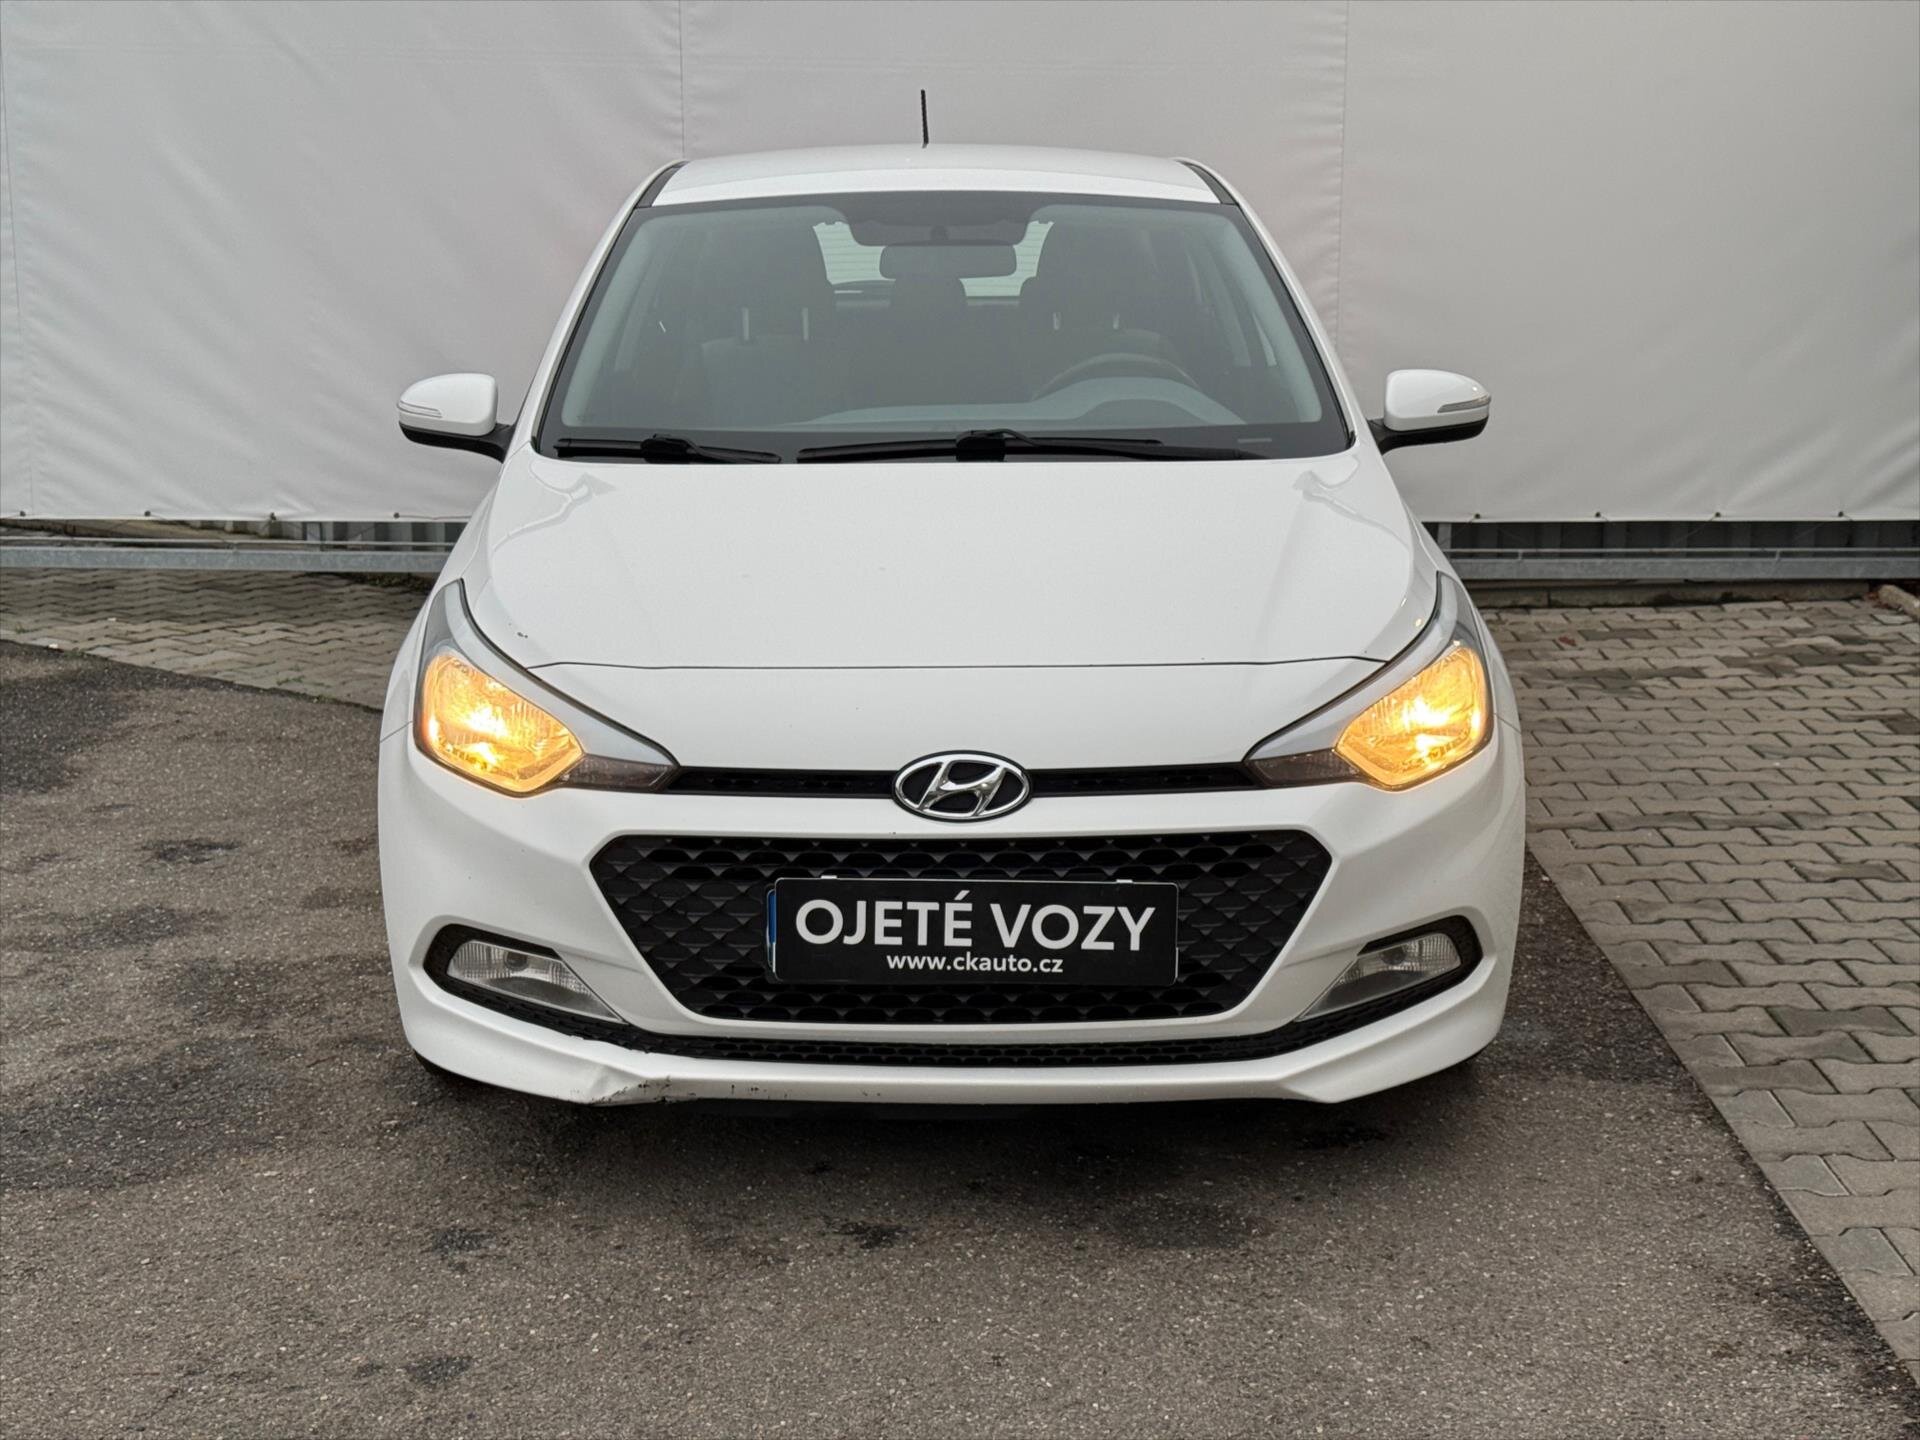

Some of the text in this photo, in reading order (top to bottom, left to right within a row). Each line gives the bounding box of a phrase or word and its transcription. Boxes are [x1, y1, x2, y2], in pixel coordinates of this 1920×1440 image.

[795, 889, 1156, 951] OJETÉ VOZY
[886, 951, 1064, 974] www.ckauto.cz
